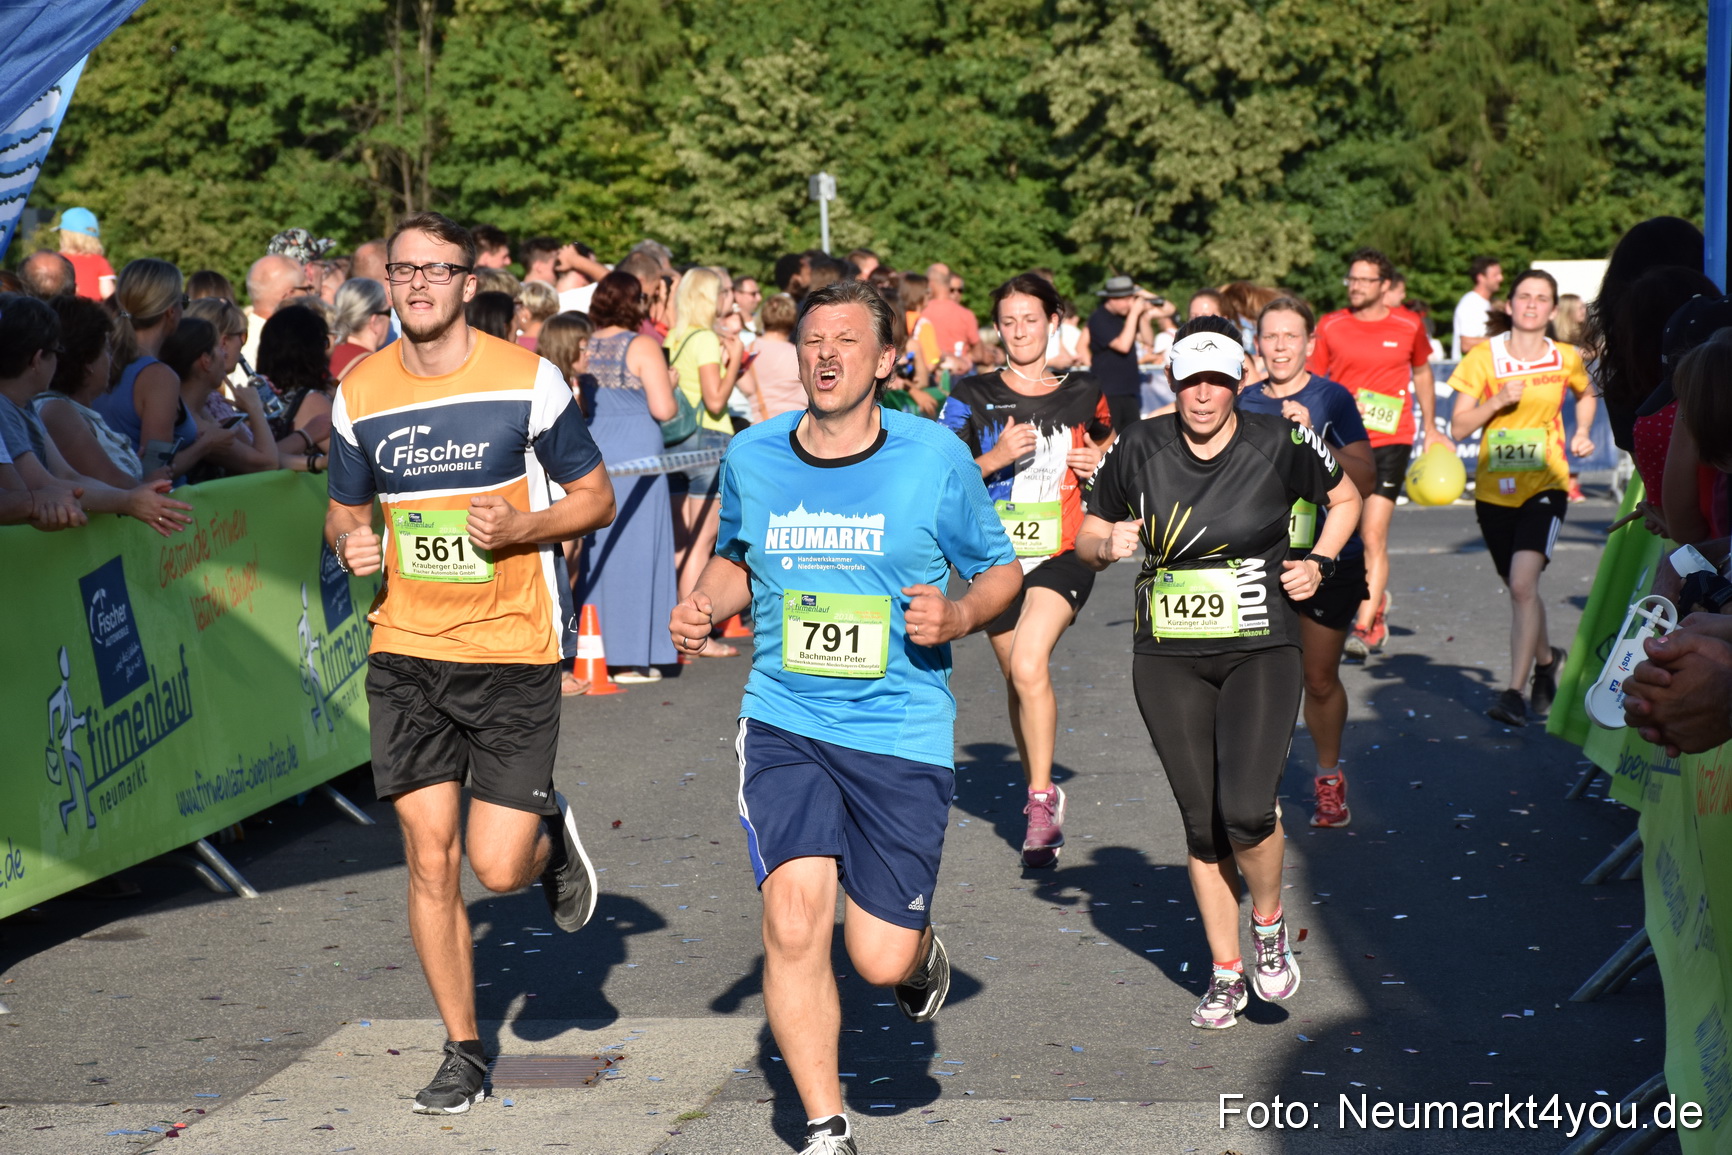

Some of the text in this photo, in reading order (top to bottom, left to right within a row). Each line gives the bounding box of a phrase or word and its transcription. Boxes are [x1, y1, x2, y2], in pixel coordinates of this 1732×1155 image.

[392, 439, 490, 467] Fischer
[1494, 444, 1537, 459] 1217
[402, 460, 482, 477] AUTOMOBILE
[764, 527, 885, 552] NEUMARKT
[1012, 521, 1040, 540] 42
[414, 536, 465, 562] 561
[411, 561, 450, 571] Krauberger
[797, 563, 866, 571] Niederbayern-Oberpfalz
[1159, 593, 1225, 619] 1429
[97, 603, 128, 637] Fischer
[1167, 619, 1200, 627] Kürzinger
[802, 621, 860, 654] 791
[799, 651, 867, 663] Bachmann Peter
[1621, 651, 1633, 667] SDK
[85, 643, 194, 785] firmenlauf
[99, 763, 148, 815] neumarkt
[907, 903, 926, 911] adidas
